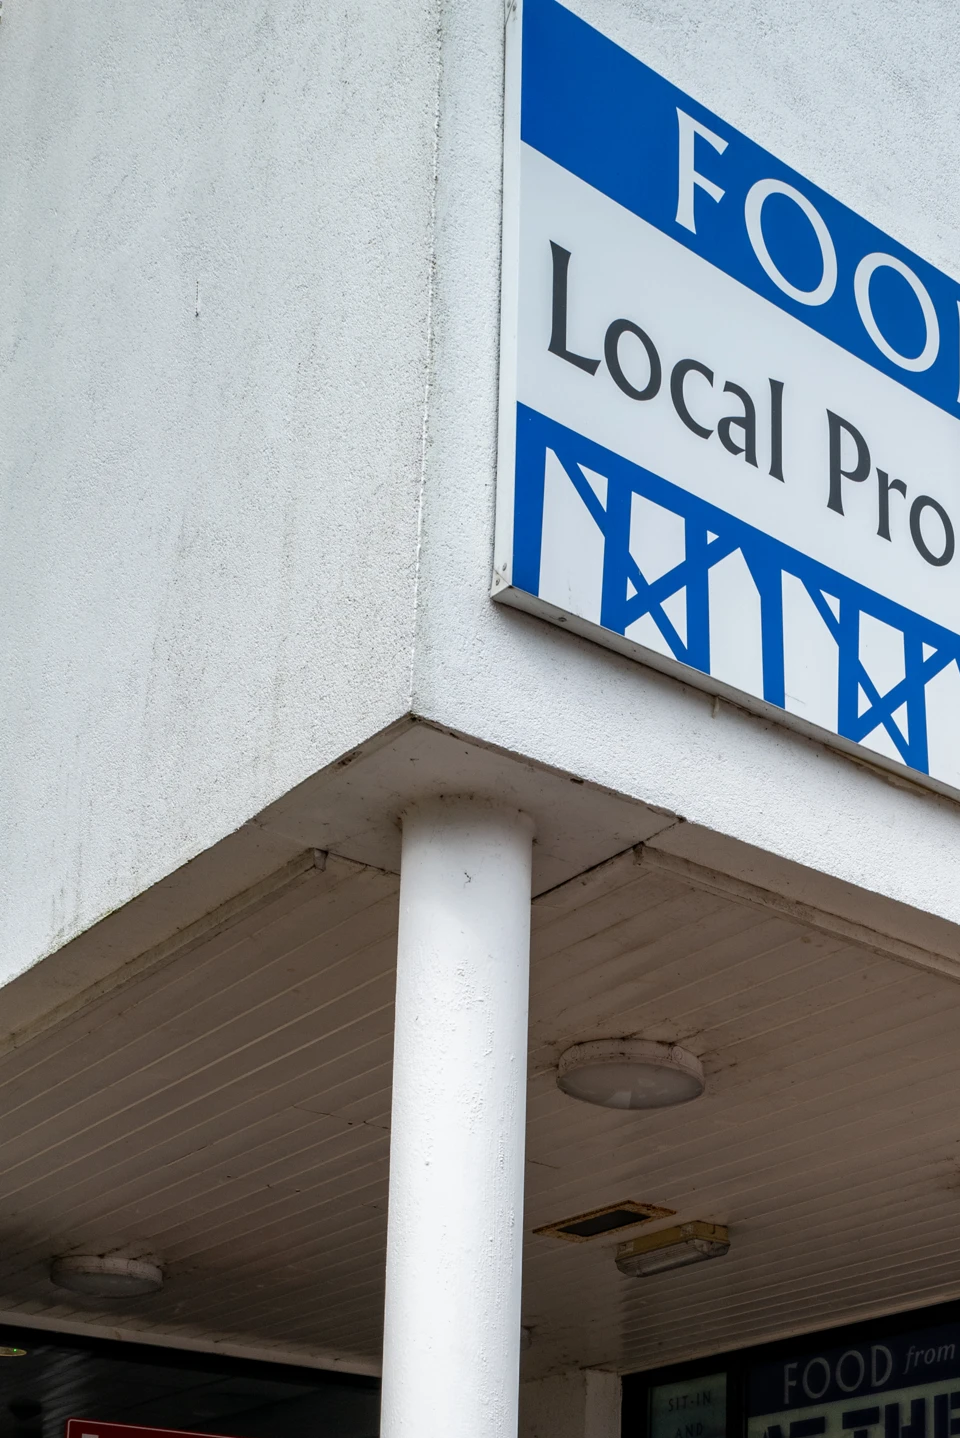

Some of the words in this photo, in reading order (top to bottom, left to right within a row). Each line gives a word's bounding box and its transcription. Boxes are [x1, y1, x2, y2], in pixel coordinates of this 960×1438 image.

[547, 239, 785, 483] Local
[668, 1390, 711, 1412] SIT-IN
[783, 1345, 893, 1406] FOOD
[904, 1339, 956, 1376] from
